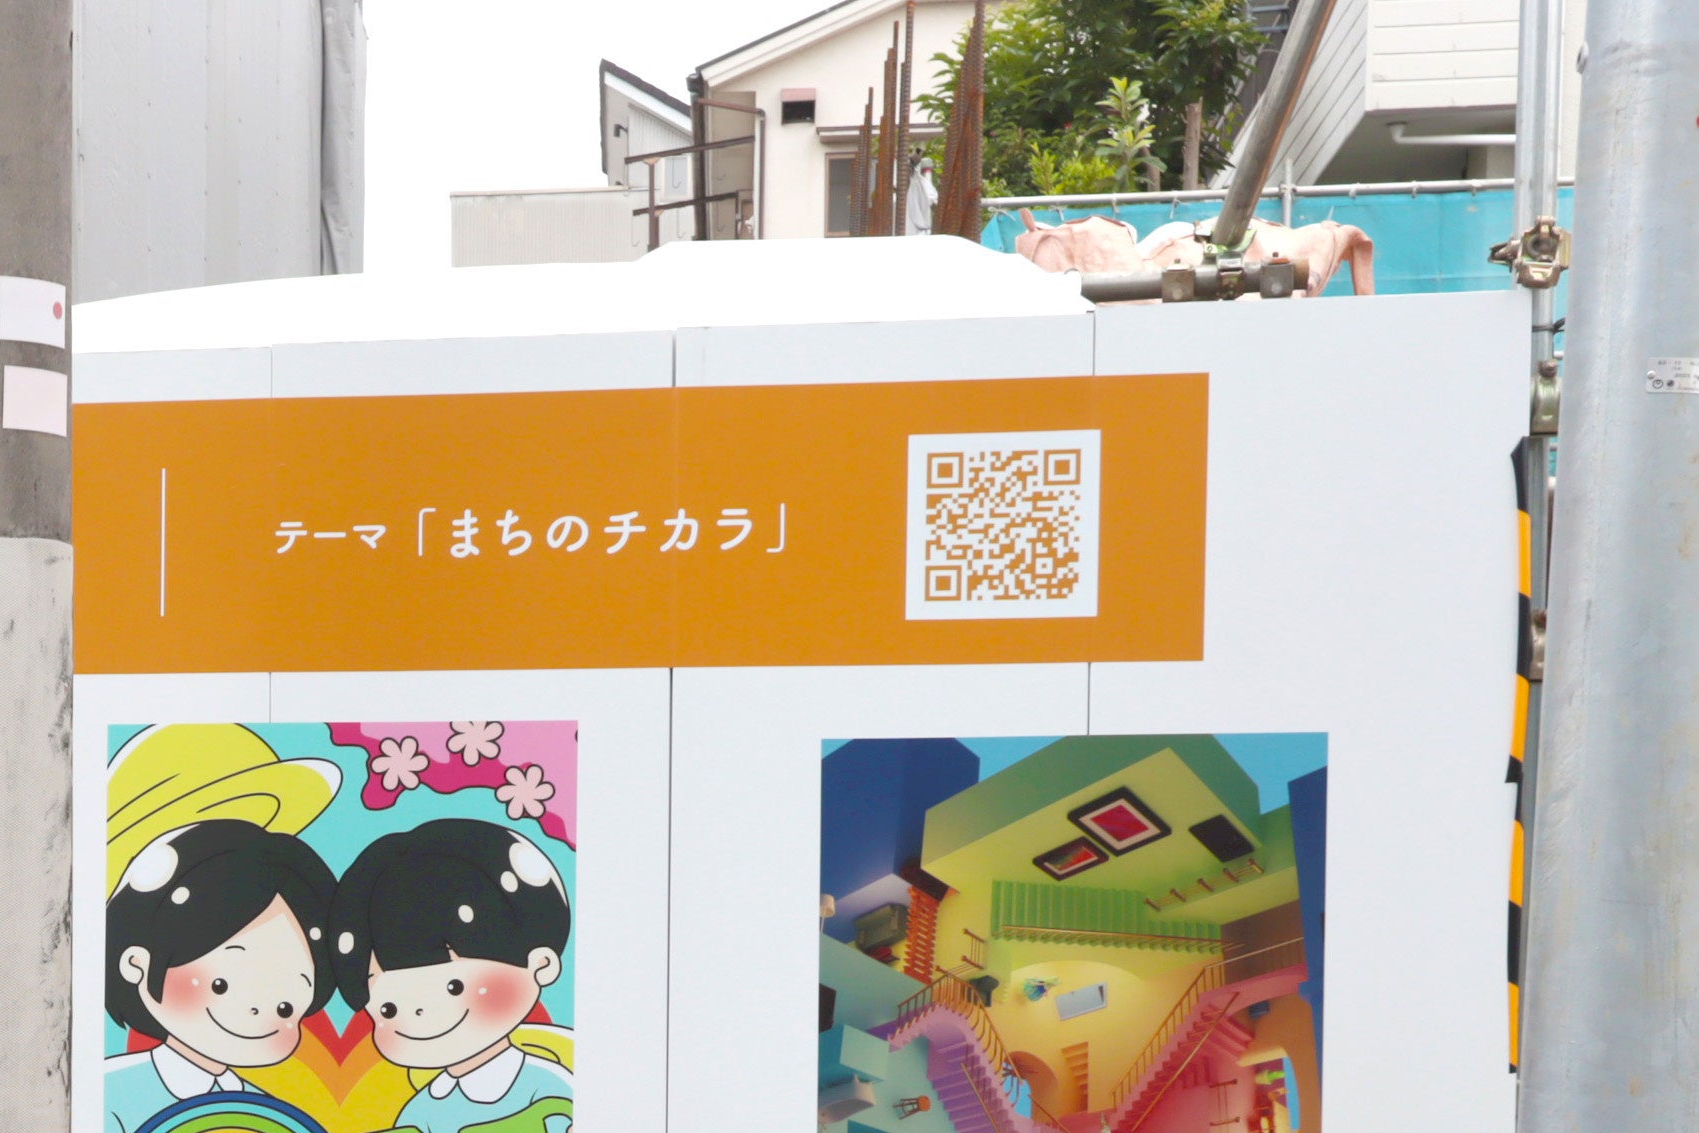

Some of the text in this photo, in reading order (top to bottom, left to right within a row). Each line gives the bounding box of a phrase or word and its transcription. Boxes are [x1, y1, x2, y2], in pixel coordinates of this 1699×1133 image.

[275, 503, 786, 559] テーマ「まちのチカラ」
